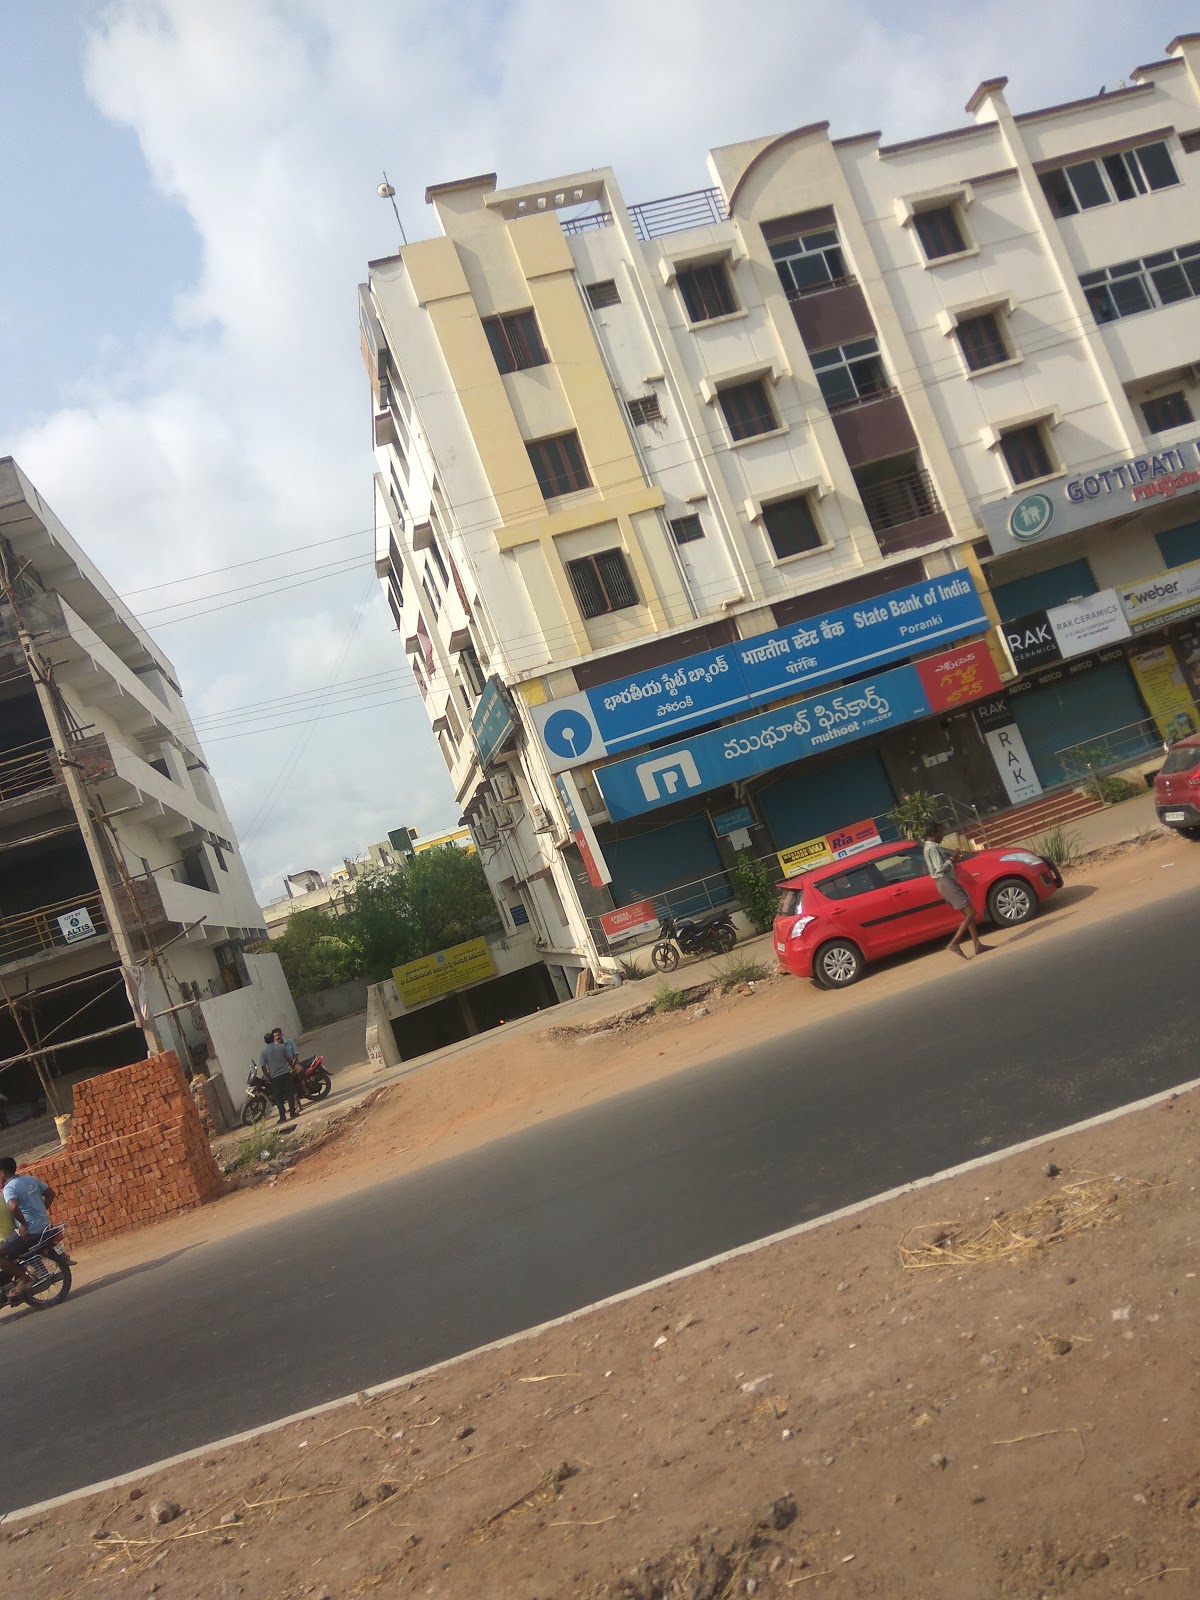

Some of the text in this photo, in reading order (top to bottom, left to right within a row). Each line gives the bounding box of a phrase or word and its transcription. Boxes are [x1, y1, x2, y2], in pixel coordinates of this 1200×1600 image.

[1065, 448, 1186, 504] GOTTIPATI
[853, 579, 971, 629] State Bank of India
[1135, 581, 1178, 604] weber
[899, 614, 944, 637] Poranki
[1056, 604, 1118, 631] RAK CERAMICS
[741, 619, 846, 665] भारतीय स्टेट बैंक
[1007, 623, 1052, 652] RAK
[1014, 643, 1057, 662] CERAMICS
[603, 680, 662, 711] భారతీయ
[688, 654, 729, 683] బ్యాంక్
[1009, 650, 1123, 695] NITCO NITCO NITCO NITCO
[978, 700, 1007, 718] RAK
[810, 711, 893, 746] muthoot FINCORP
[783, 848, 809, 860] WESTERN
[832, 833, 853, 850] Ria
[791, 852, 809, 861] UNION
[67, 923, 90, 936] ALTIS
